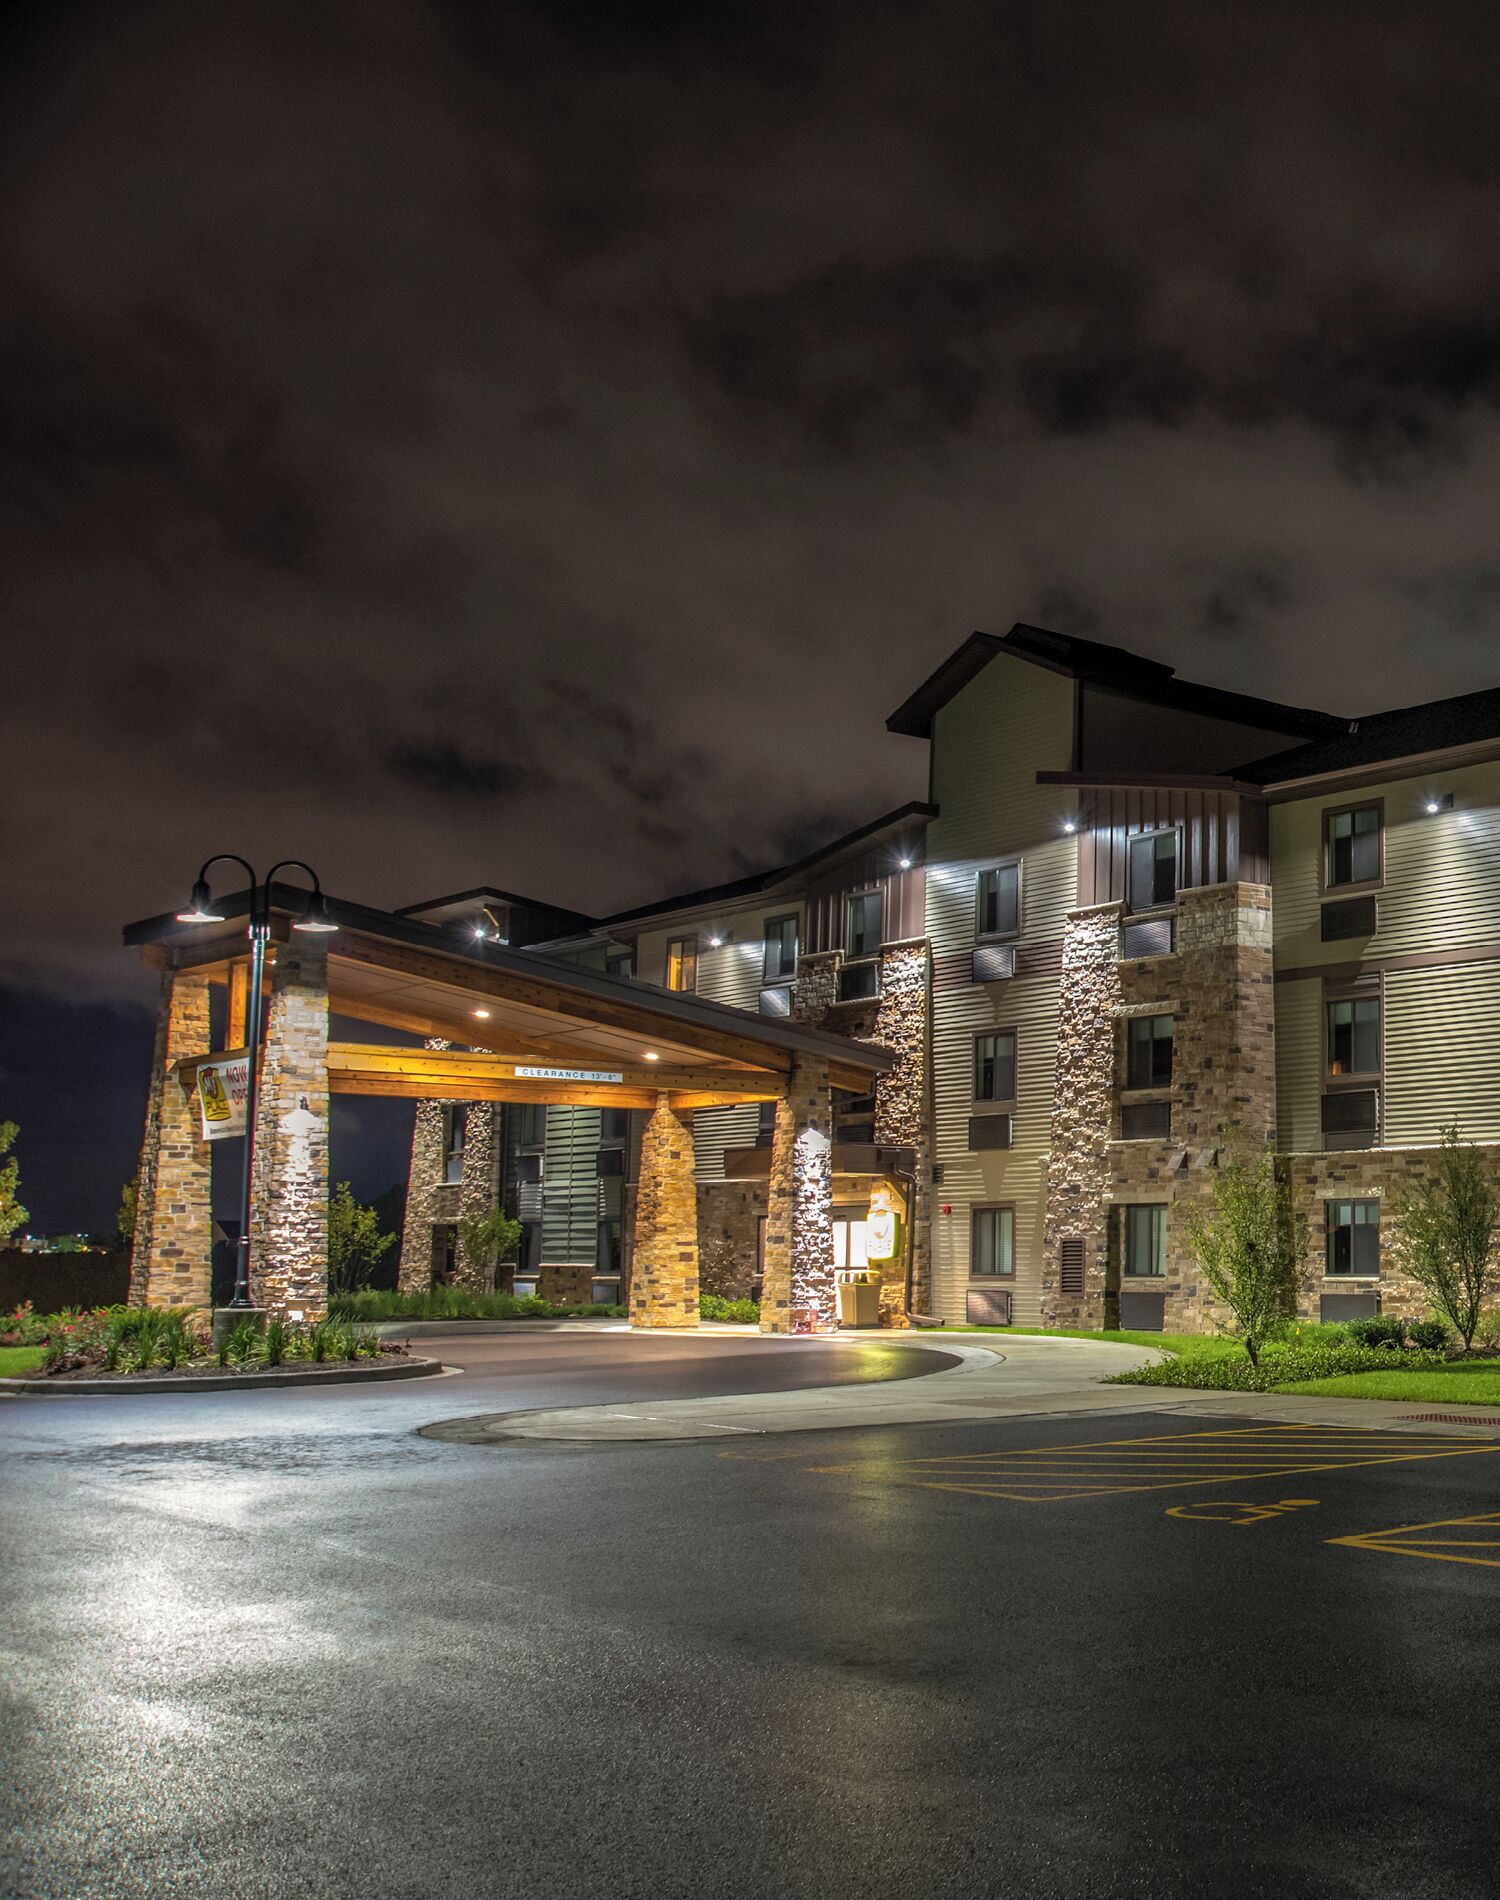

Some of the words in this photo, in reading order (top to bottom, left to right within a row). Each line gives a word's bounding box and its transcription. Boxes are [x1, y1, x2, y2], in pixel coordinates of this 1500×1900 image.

[226, 1066, 248, 1084] NOW
[522, 1068, 586, 1079] CLEARANCE
[231, 1088, 248, 1106] OPE
